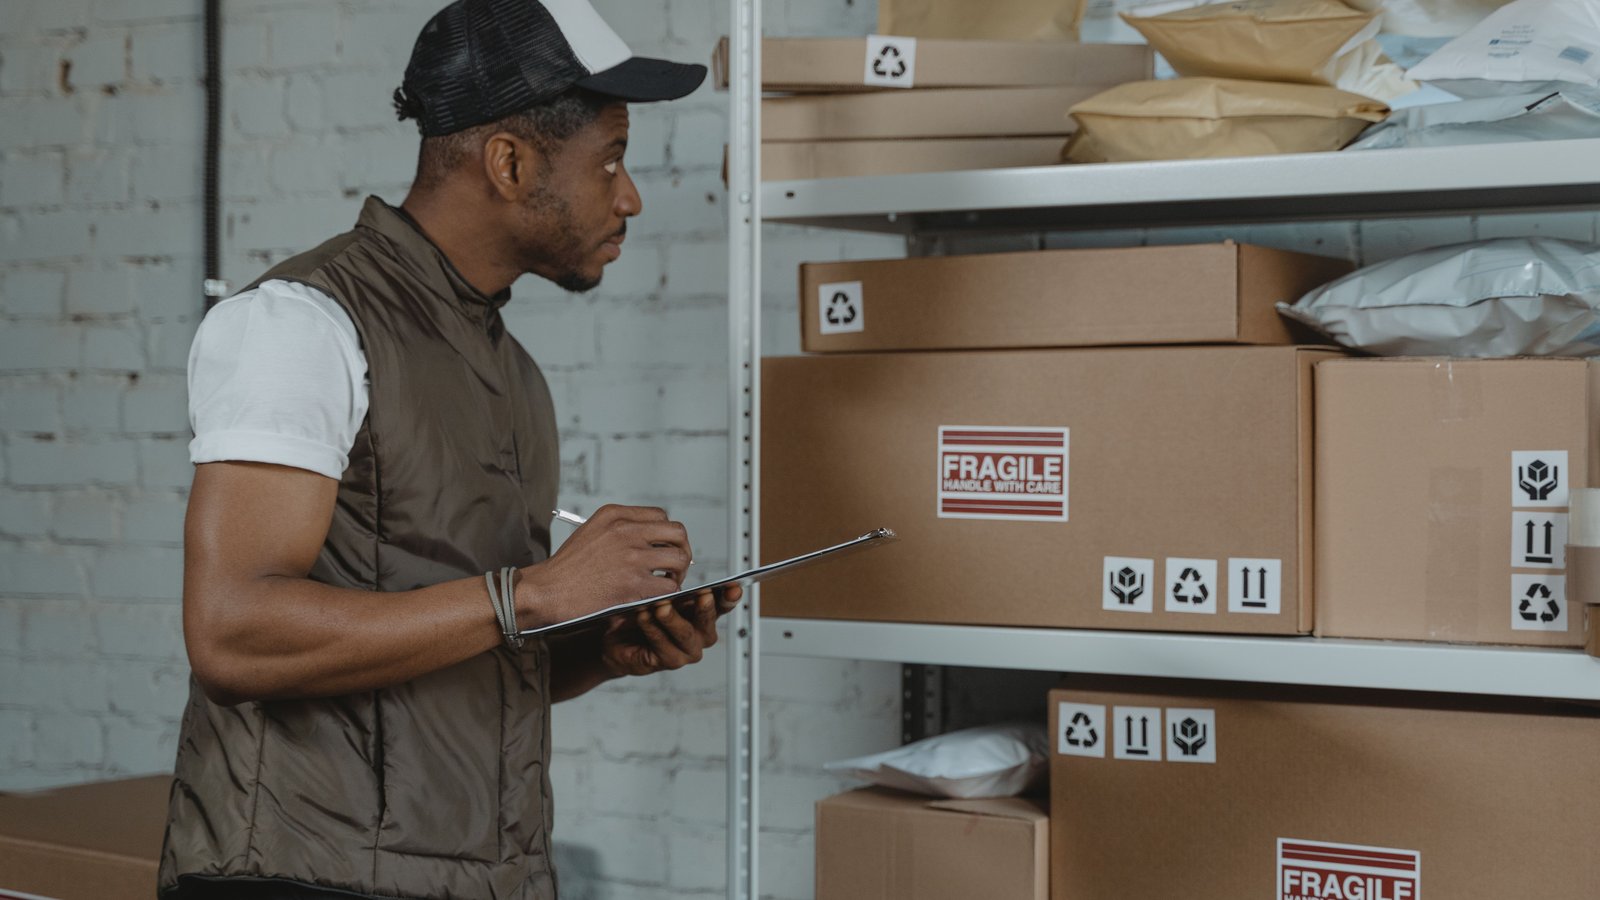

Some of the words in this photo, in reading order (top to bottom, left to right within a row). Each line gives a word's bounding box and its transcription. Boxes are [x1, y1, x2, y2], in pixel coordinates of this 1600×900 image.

[943, 455, 1061, 481] FRAGILE
[943, 480, 992, 492] HANDLE
[994, 481, 1025, 492] WITH
[1026, 481, 1061, 494] CARE
[1283, 869, 1413, 900] FRAGILE
